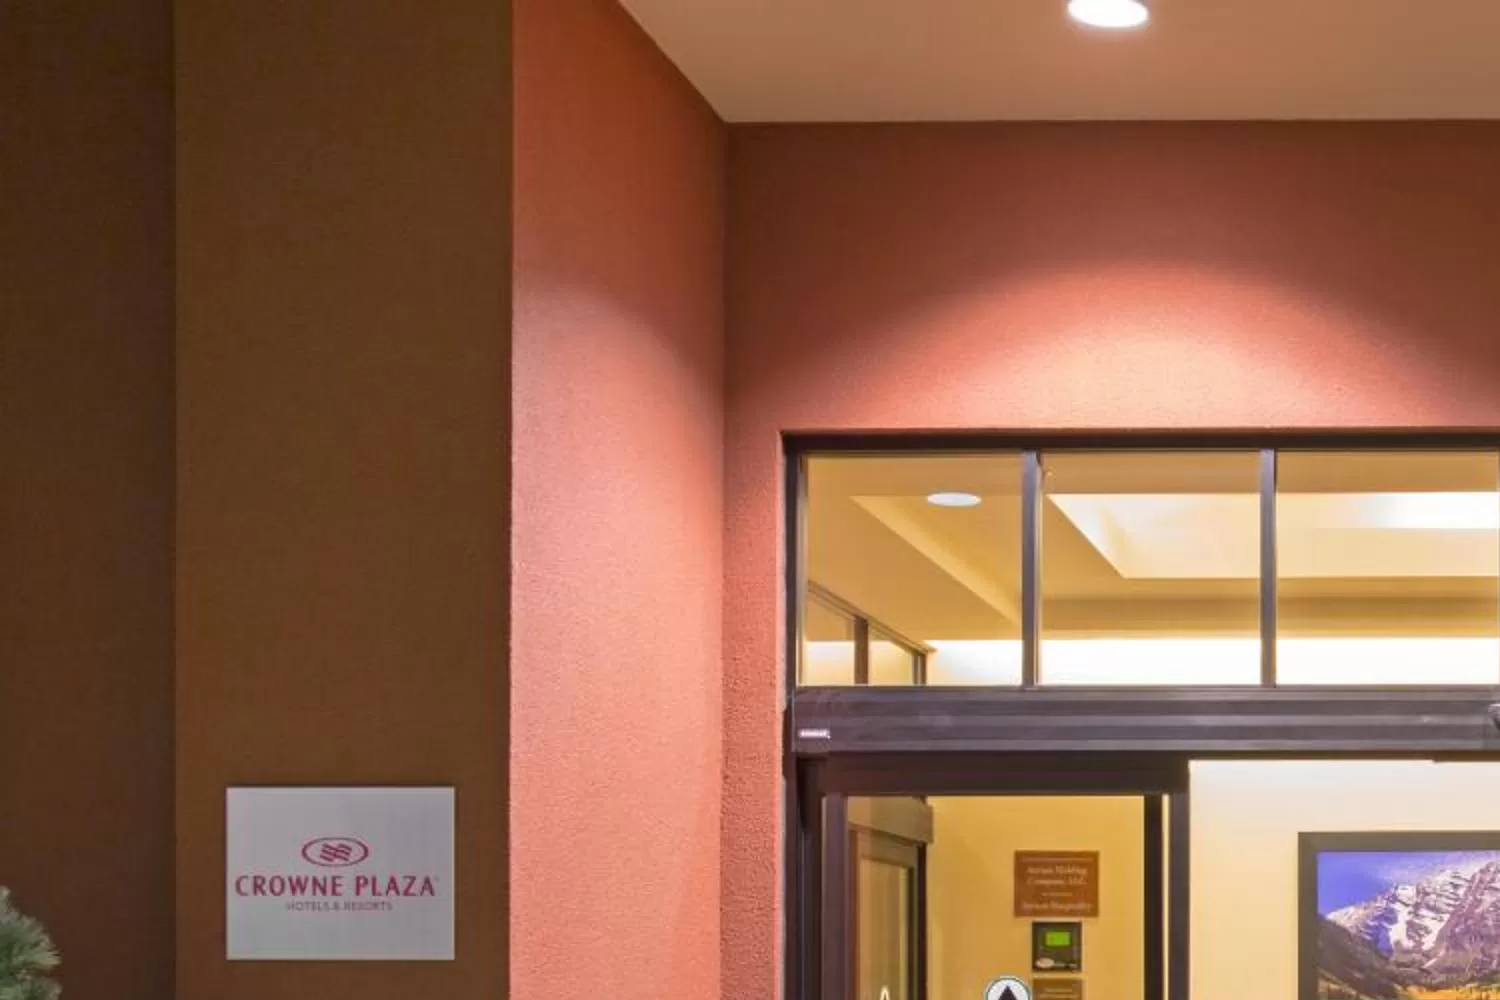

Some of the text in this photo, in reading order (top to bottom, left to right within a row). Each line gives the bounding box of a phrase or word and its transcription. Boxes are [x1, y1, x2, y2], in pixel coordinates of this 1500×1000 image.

[235, 875, 435, 897] CROWNE PLAZA
[287, 901, 393, 912] HOTELS & RESORTS
